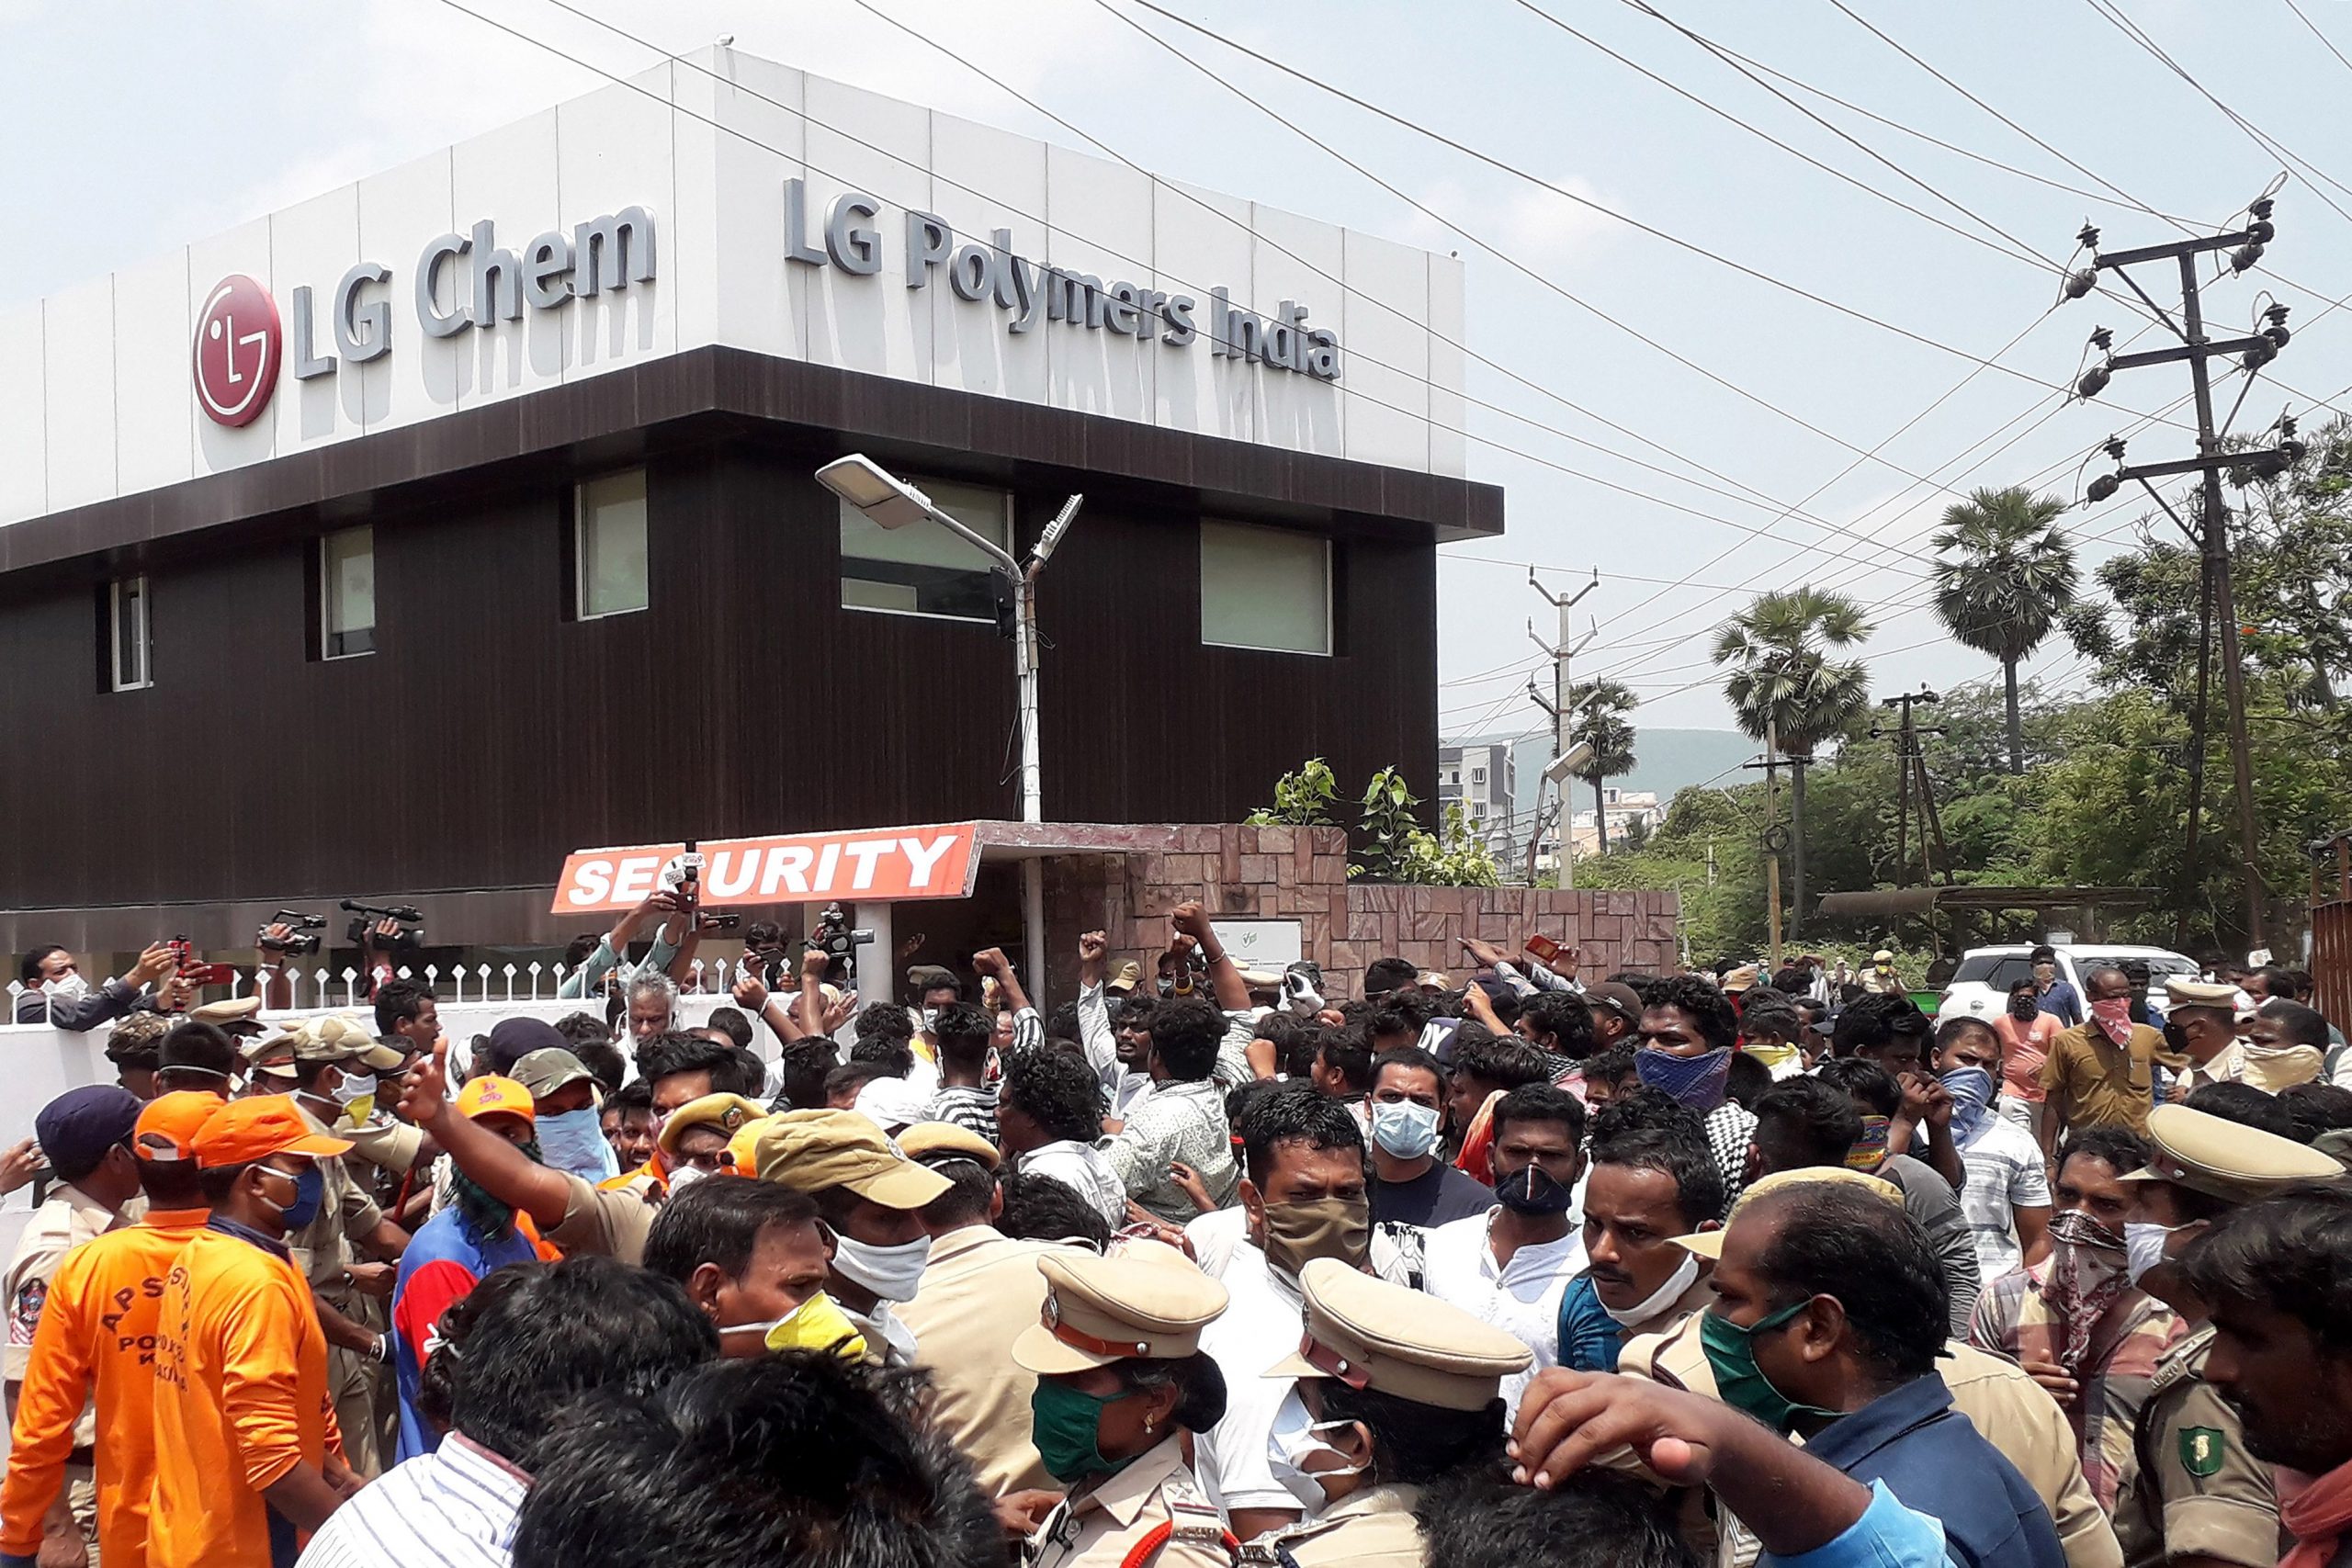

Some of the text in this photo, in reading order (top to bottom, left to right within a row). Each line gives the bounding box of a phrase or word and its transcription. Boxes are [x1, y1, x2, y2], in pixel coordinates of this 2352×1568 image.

[293, 205, 656, 379] LG Chem
[784, 178, 1340, 379] LG Polymers India
